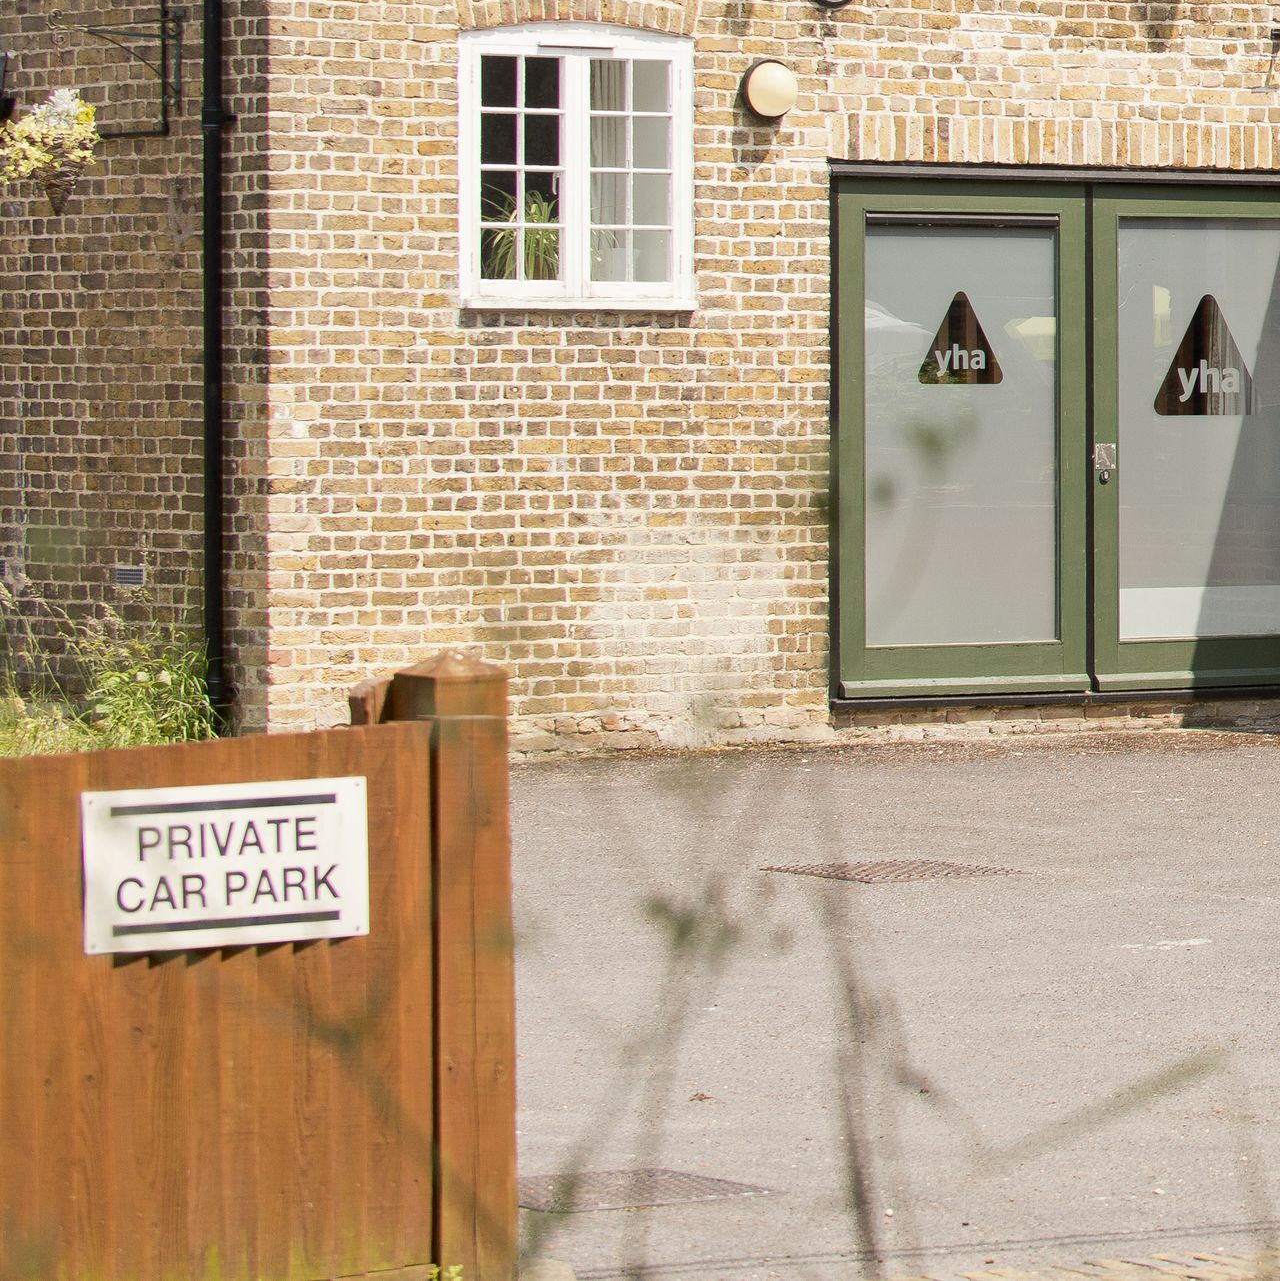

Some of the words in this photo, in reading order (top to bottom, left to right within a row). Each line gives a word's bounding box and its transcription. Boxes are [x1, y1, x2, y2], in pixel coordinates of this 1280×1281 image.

[934, 343, 986, 377] yha
[1177, 359, 1241, 402] yha
[138, 816, 318, 862] PRIVATE
[116, 874, 207, 913] CAR
[225, 864, 340, 906] PARK
